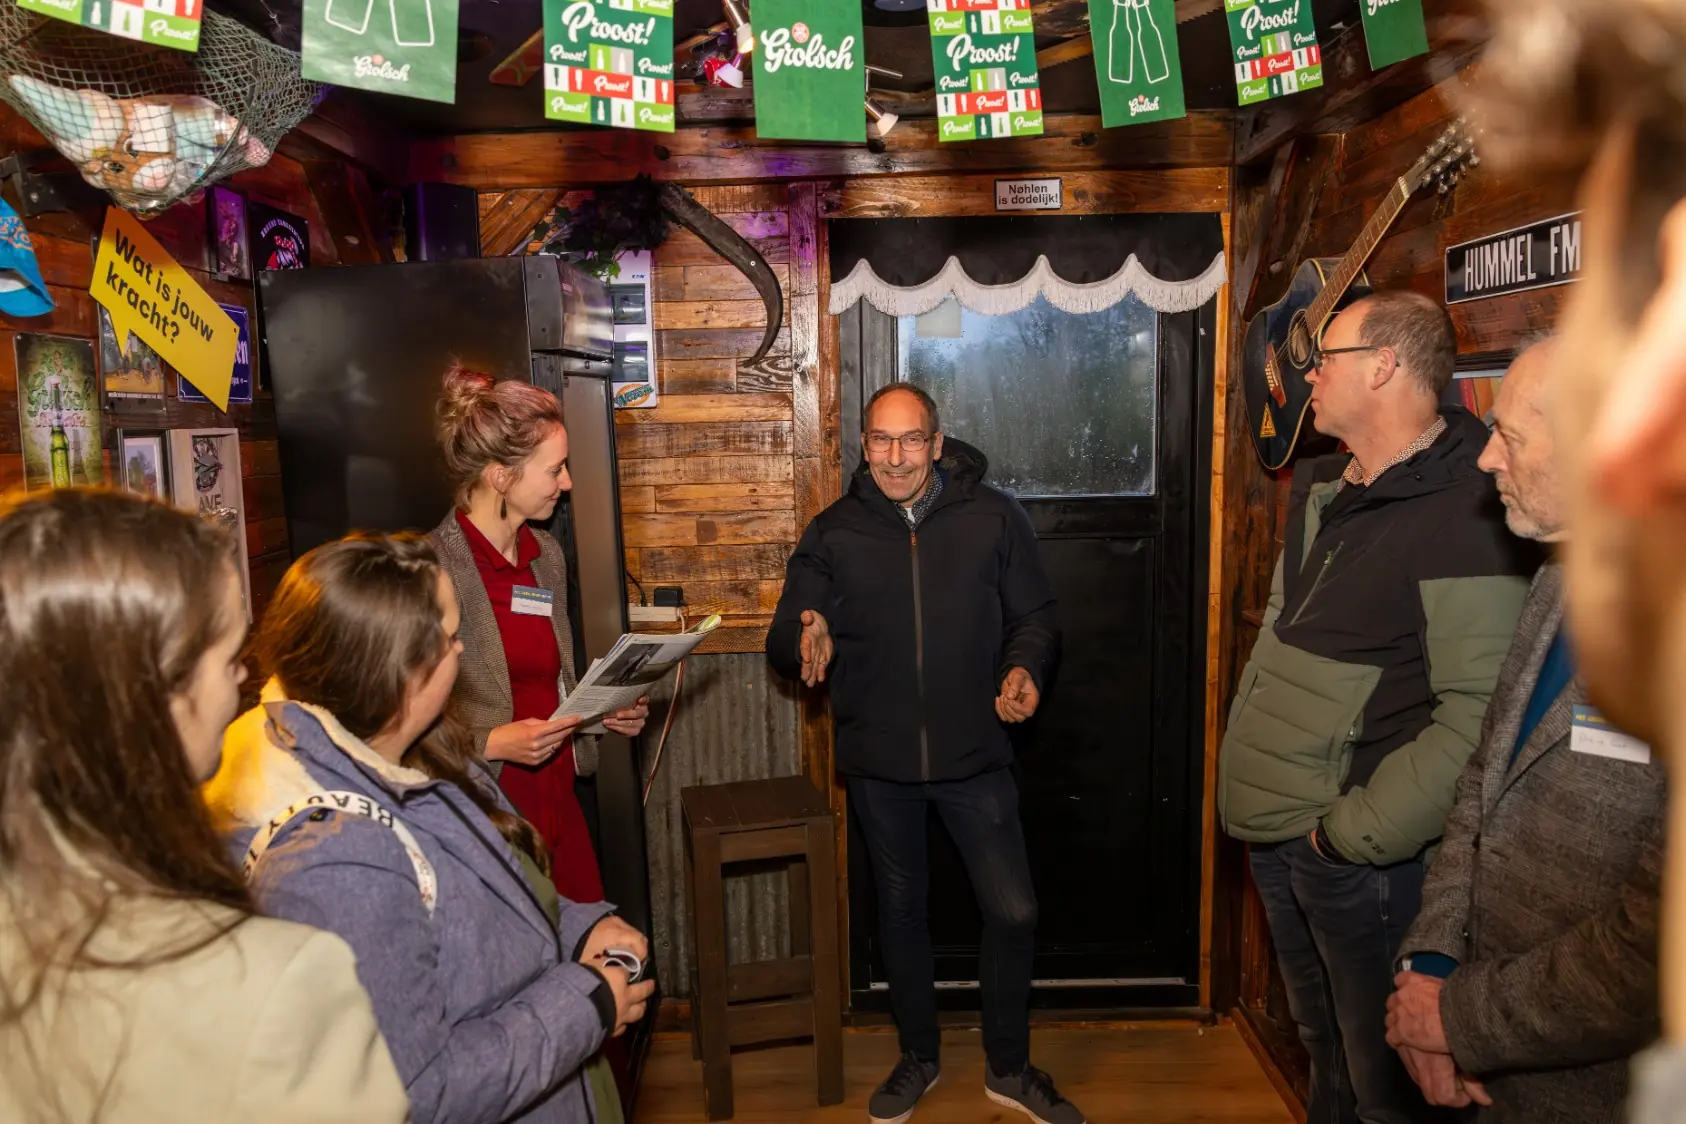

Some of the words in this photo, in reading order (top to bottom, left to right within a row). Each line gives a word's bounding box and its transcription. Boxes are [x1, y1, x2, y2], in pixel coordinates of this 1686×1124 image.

[561, 1, 656, 45] Proost!
[1240, 0, 1299, 40] Proost!
[353, 55, 411, 82] Grolsch
[760, 27, 855, 73] Grolsch
[946, 33, 1020, 72] Proost!
[1128, 95, 1160, 117] Grolsch
[998, 196, 1008, 205] is
[1011, 193, 1058, 206] dodelijk!
[1008, 184, 1048, 195] Nøhlen
[1464, 233, 1537, 293] HUMMEL
[1550, 220, 1582, 277] FM
[105, 261, 180, 344] kracht?
[115, 228, 153, 285] Wat
[155, 271, 172, 302] is
[171, 289, 214, 342] jouw
